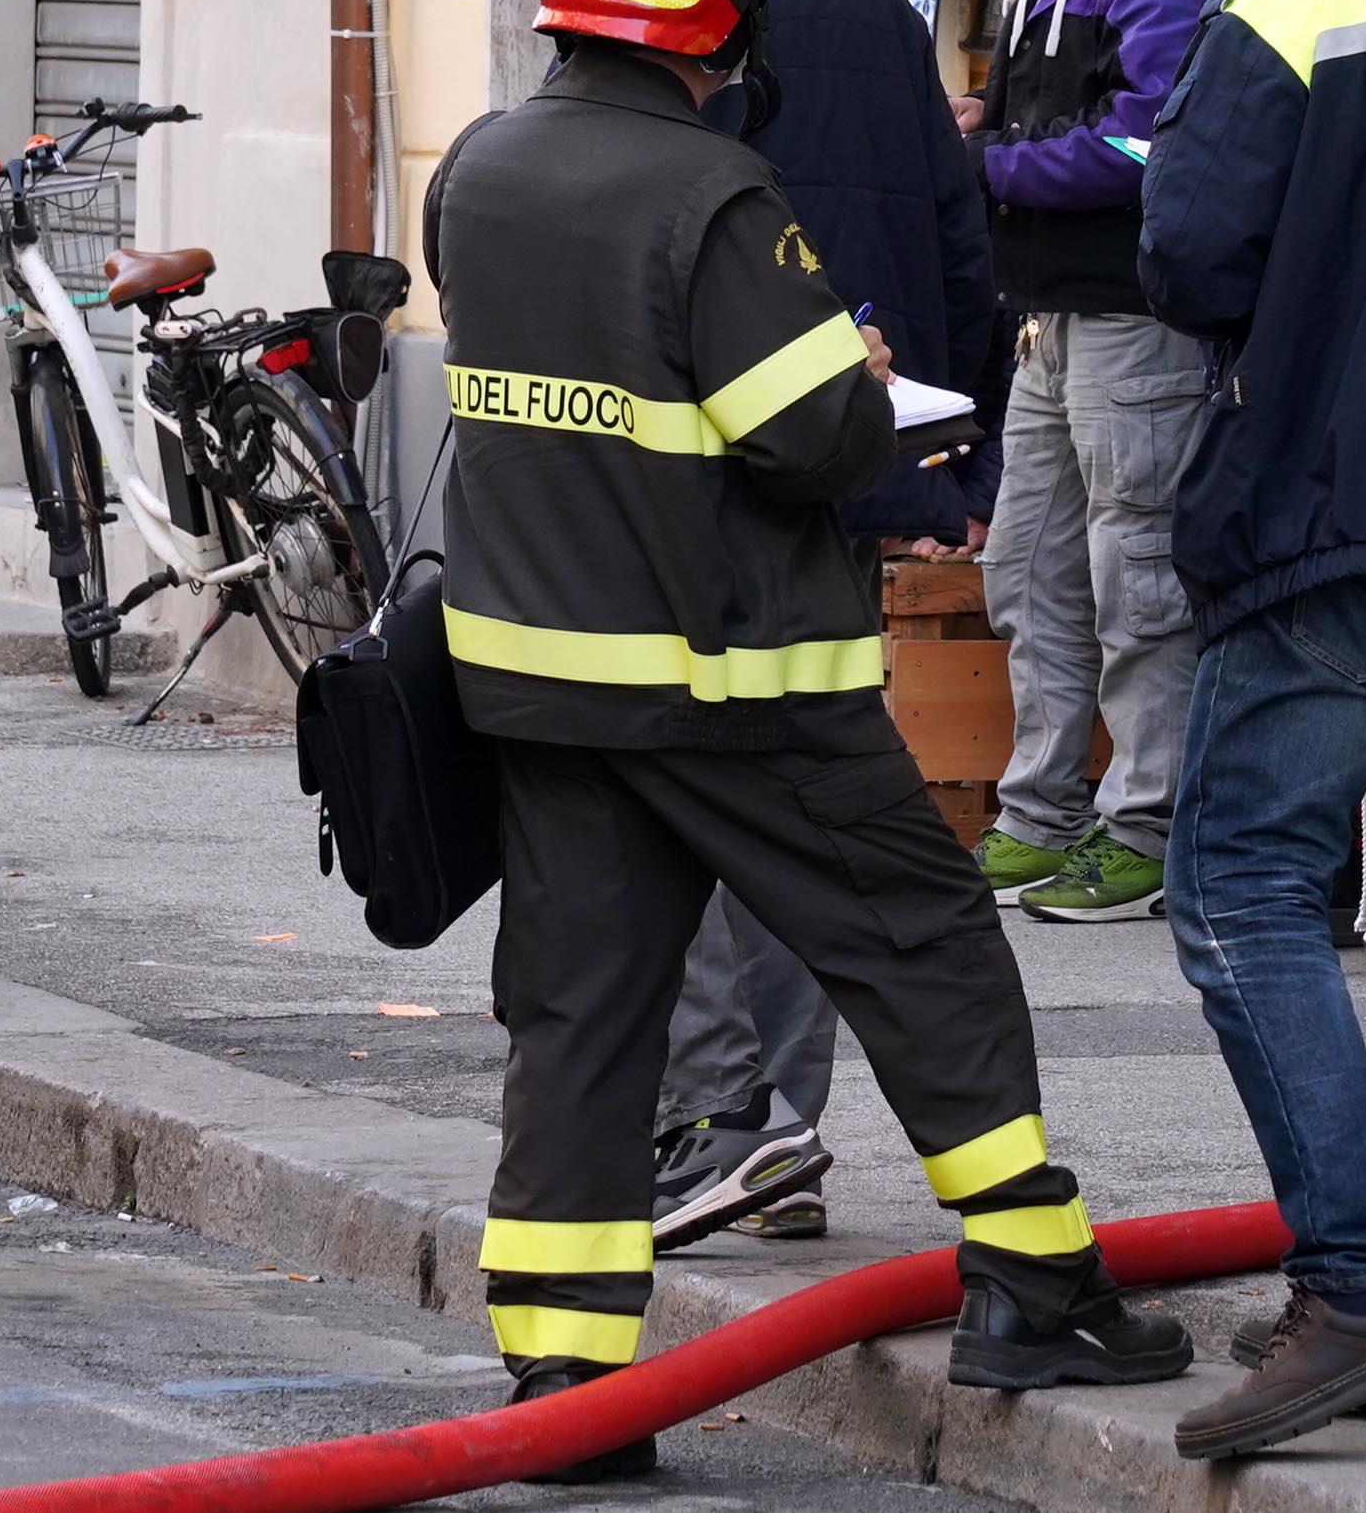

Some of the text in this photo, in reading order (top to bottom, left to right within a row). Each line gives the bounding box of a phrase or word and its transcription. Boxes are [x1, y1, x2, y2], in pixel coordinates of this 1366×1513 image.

[783, 222, 802, 237] DEL
[467, 374, 520, 417] DEL
[527, 381, 635, 435] FUOCO
